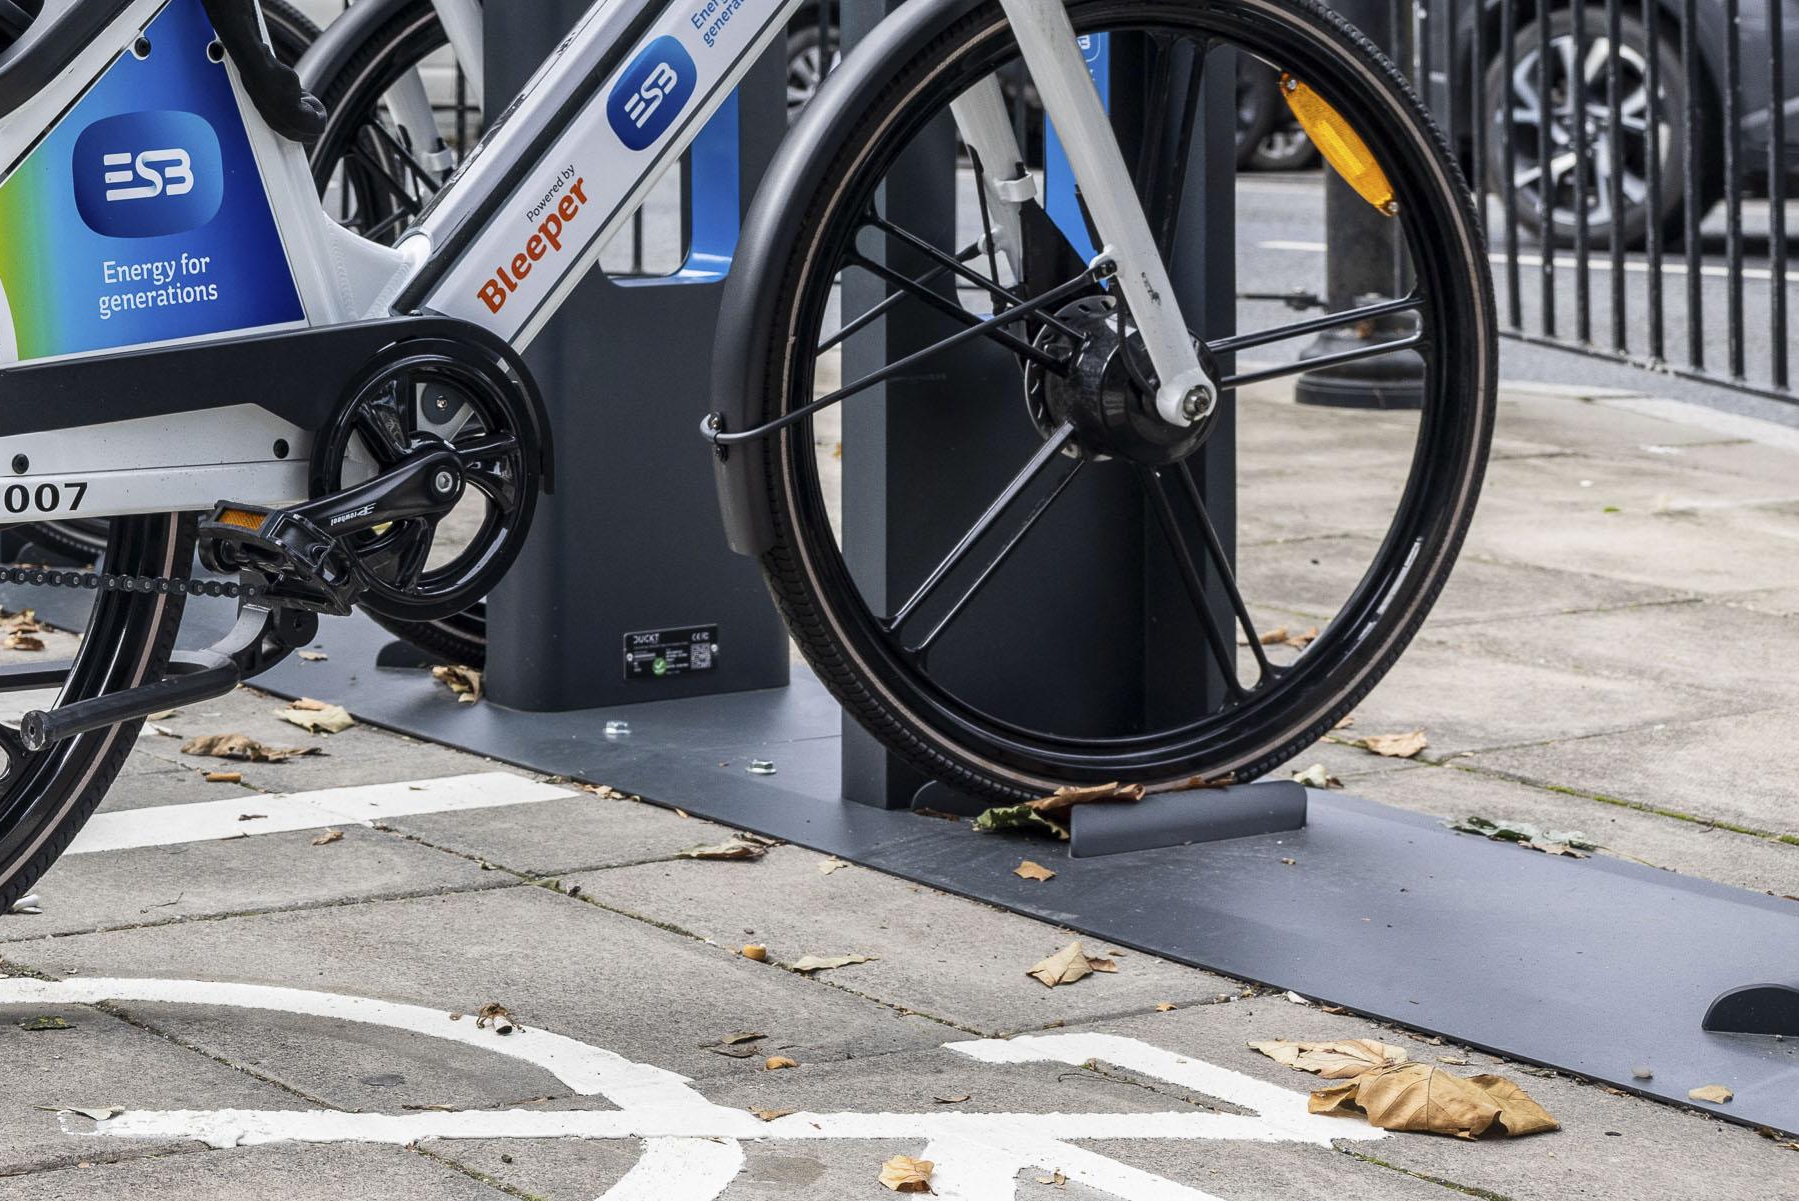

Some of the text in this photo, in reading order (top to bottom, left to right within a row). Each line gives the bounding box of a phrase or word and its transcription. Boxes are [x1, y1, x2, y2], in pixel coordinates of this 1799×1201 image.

[624, 62, 678, 129] ESB
[103, 148, 194, 202] ESB
[526, 164, 575, 223] Powered by
[103, 253, 210, 286] Energy for
[477, 177, 588, 314] Bleeper
[99, 283, 218, 320] generations
